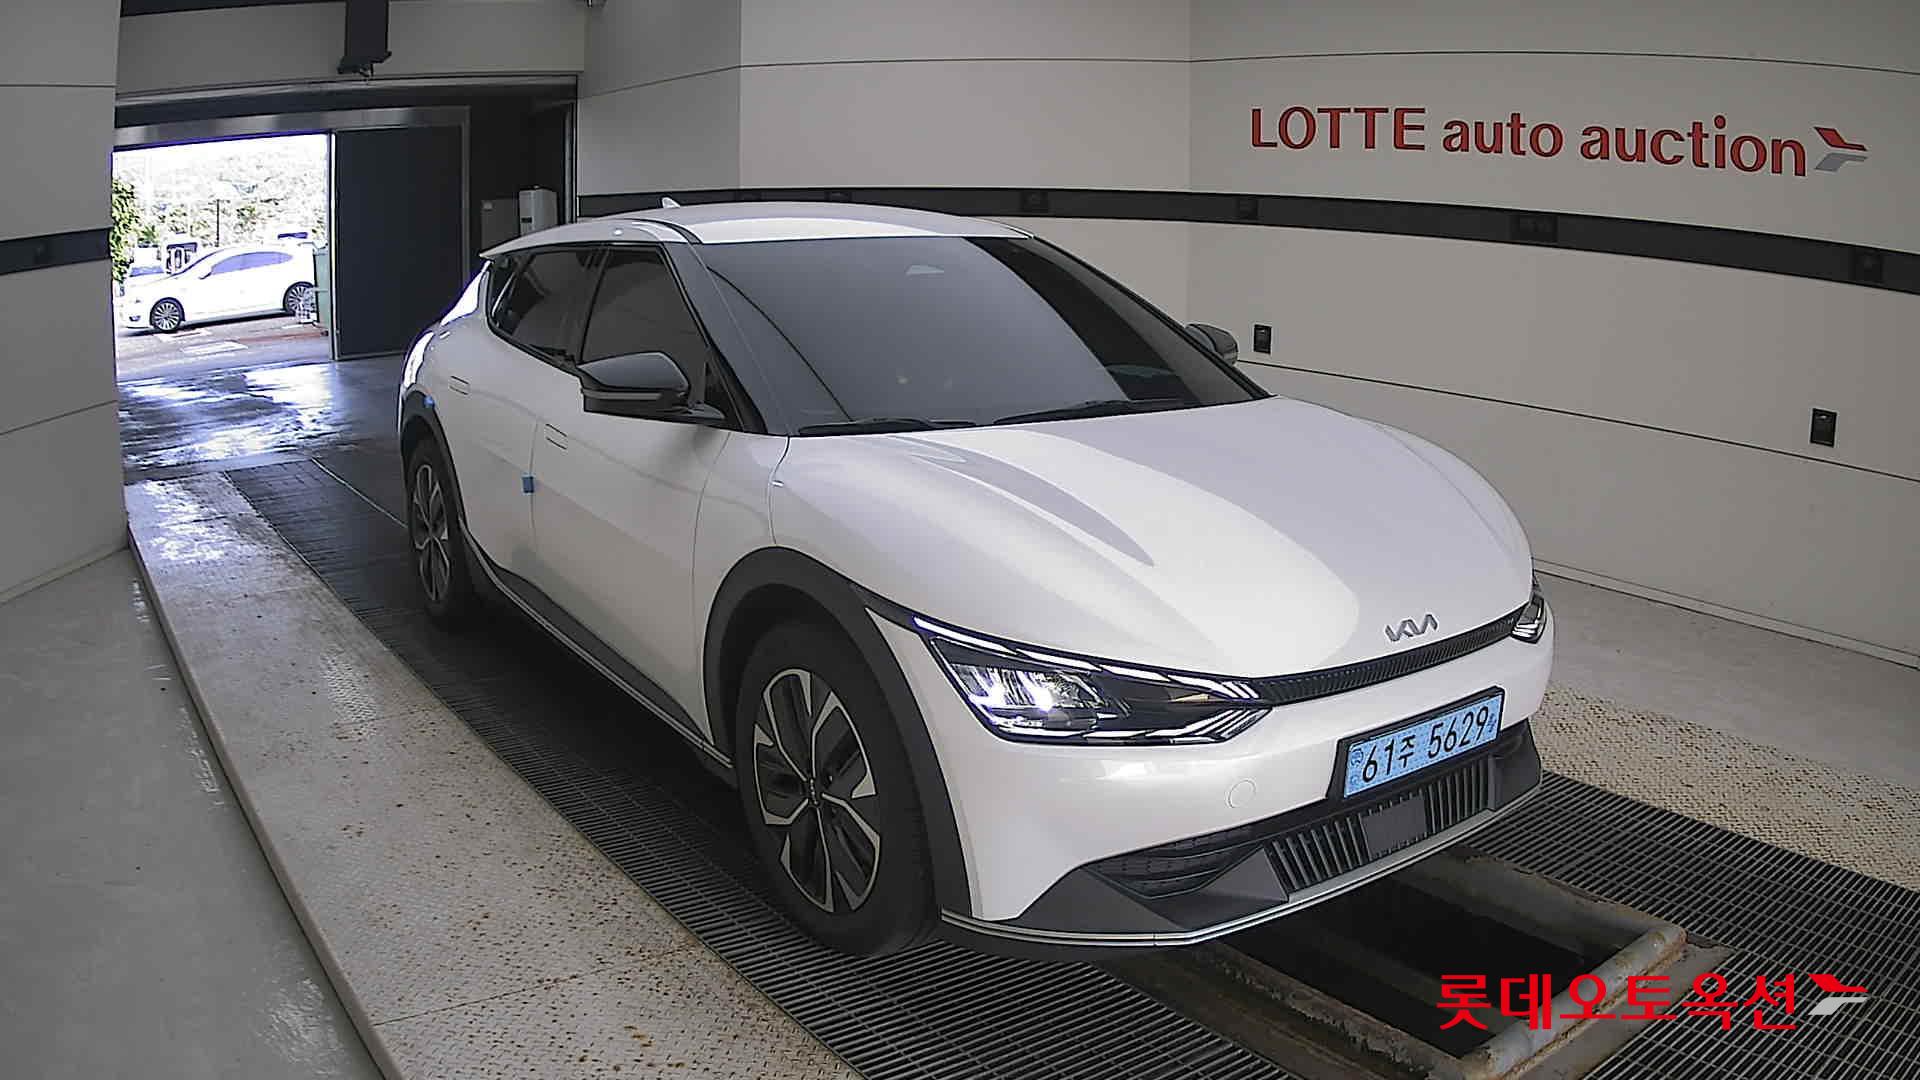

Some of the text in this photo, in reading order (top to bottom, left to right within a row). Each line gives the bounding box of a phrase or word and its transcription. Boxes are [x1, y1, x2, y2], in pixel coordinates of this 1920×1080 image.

[1251, 106, 1807, 177] LOTTE auto auction
[1362, 735, 1417, 782] 61주
[1427, 706, 1489, 758] 5629
